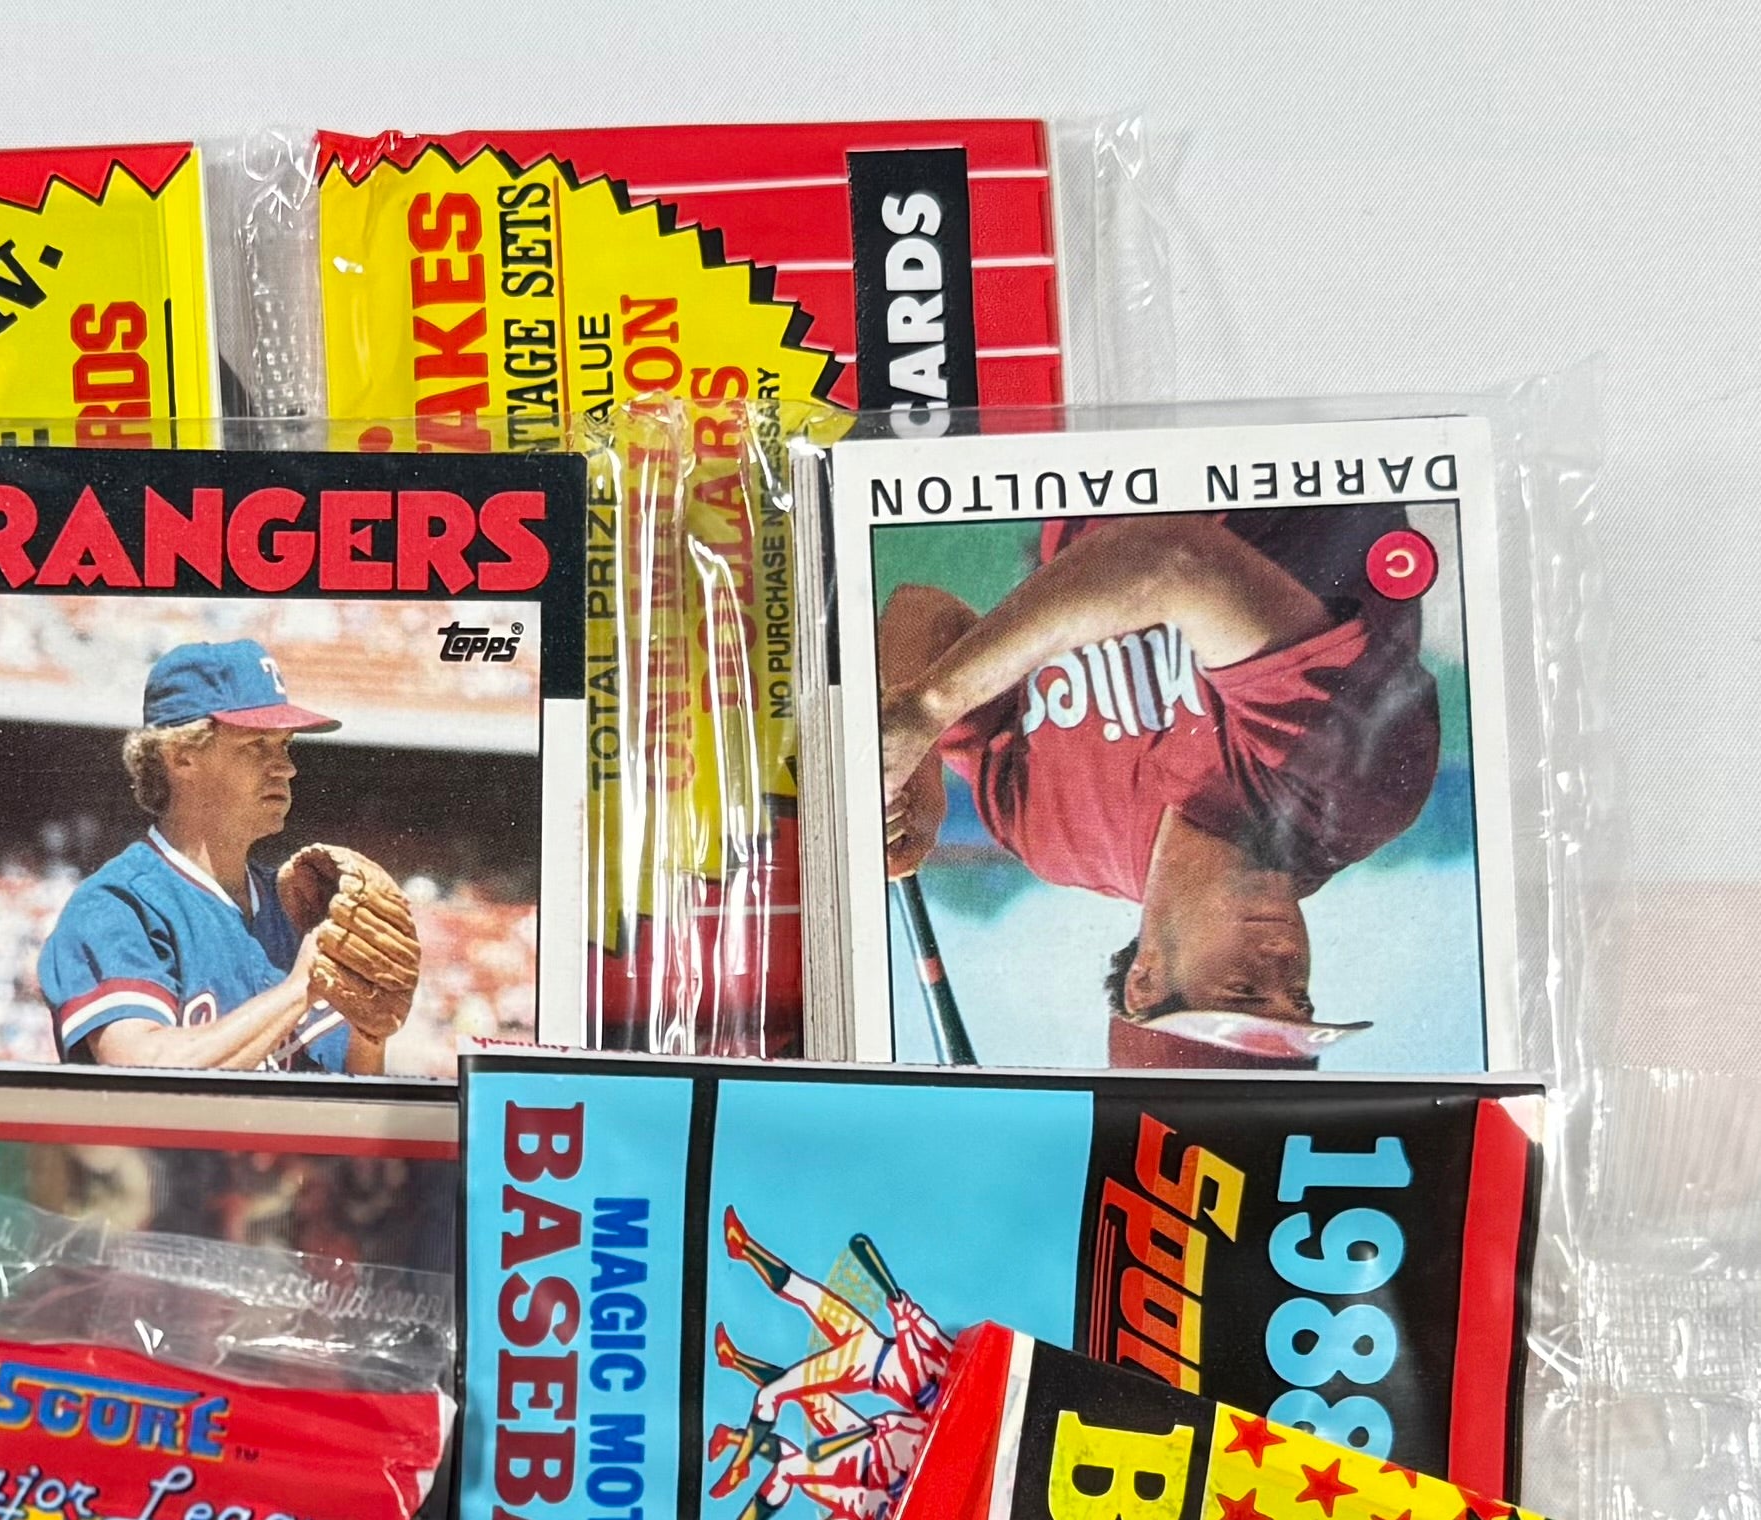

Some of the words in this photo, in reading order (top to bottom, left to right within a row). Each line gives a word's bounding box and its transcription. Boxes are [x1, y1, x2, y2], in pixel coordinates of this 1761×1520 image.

[496, 181, 555, 299] SETS
[71, 301, 151, 447] RDS
[406, 192, 489, 452] AKES
[881, 192, 952, 439] CARDS
[871, 468, 1160, 517] DAULTON
[1207, 455, 1458, 501] DARREN
[585, 483, 618, 619] PRIZE
[763, 533, 791, 678] PURCHASE
[1384, 549, 1416, 577] C
[587, 630, 621, 792] TOTAL
[769, 685, 792, 718] NO
[588, 1197, 650, 1394] MAGIC
[1265, 1134, 1413, 1461] 1988
